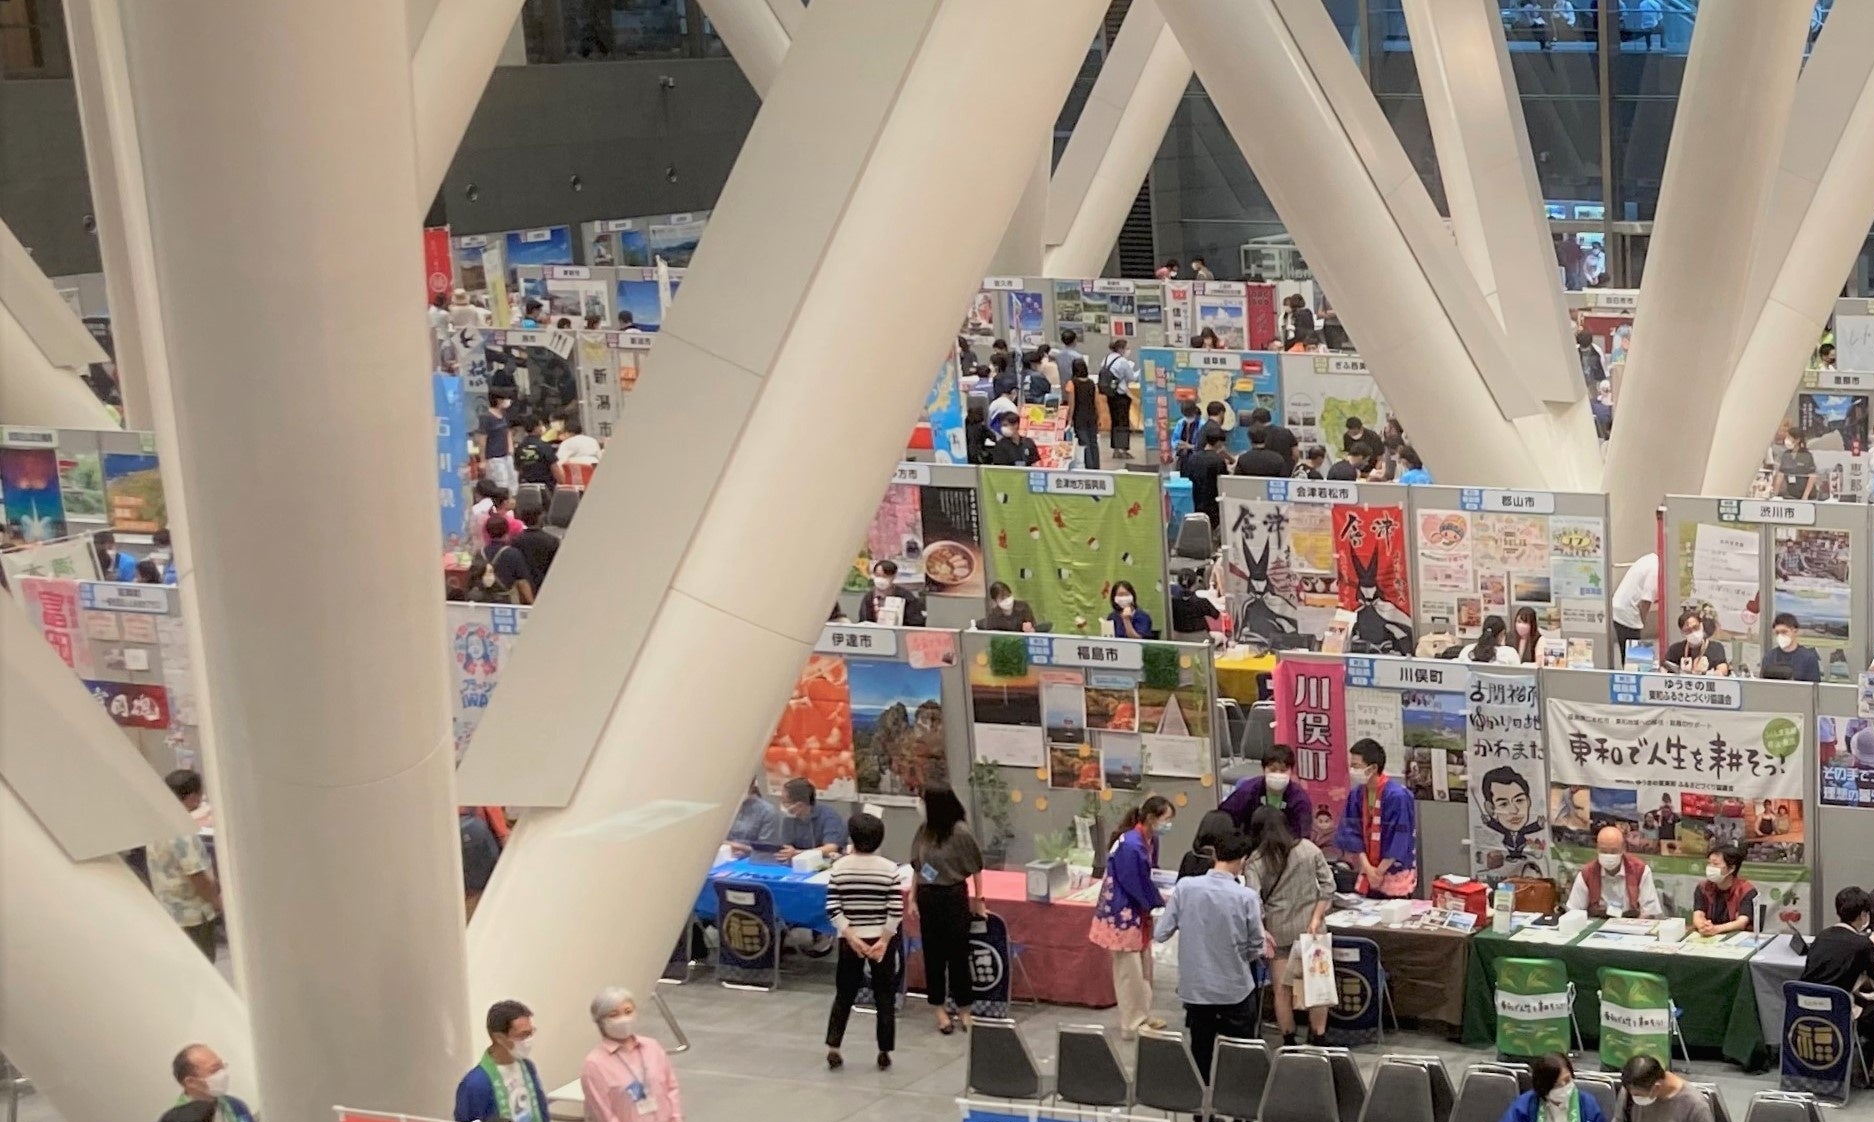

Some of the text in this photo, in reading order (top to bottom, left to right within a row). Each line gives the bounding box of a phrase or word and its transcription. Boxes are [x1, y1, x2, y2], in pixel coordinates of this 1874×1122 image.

[1055, 477, 1106, 491] 会津地方振興局
[1296, 486, 1349, 499] 会津若松市
[1501, 496, 1535, 508] 郡山市
[1760, 505, 1795, 519] 渋川市
[832, 633, 872, 648] 伊達市
[1077, 646, 1119, 661] 福島市
[1400, 667, 1443, 685] 川俣町
[1664, 679, 1716, 693] ゆうきの里
[1648, 692, 1733, 707] 東和ふるさとづくり協議会
[1294, 674, 1332, 783] 川俣町
